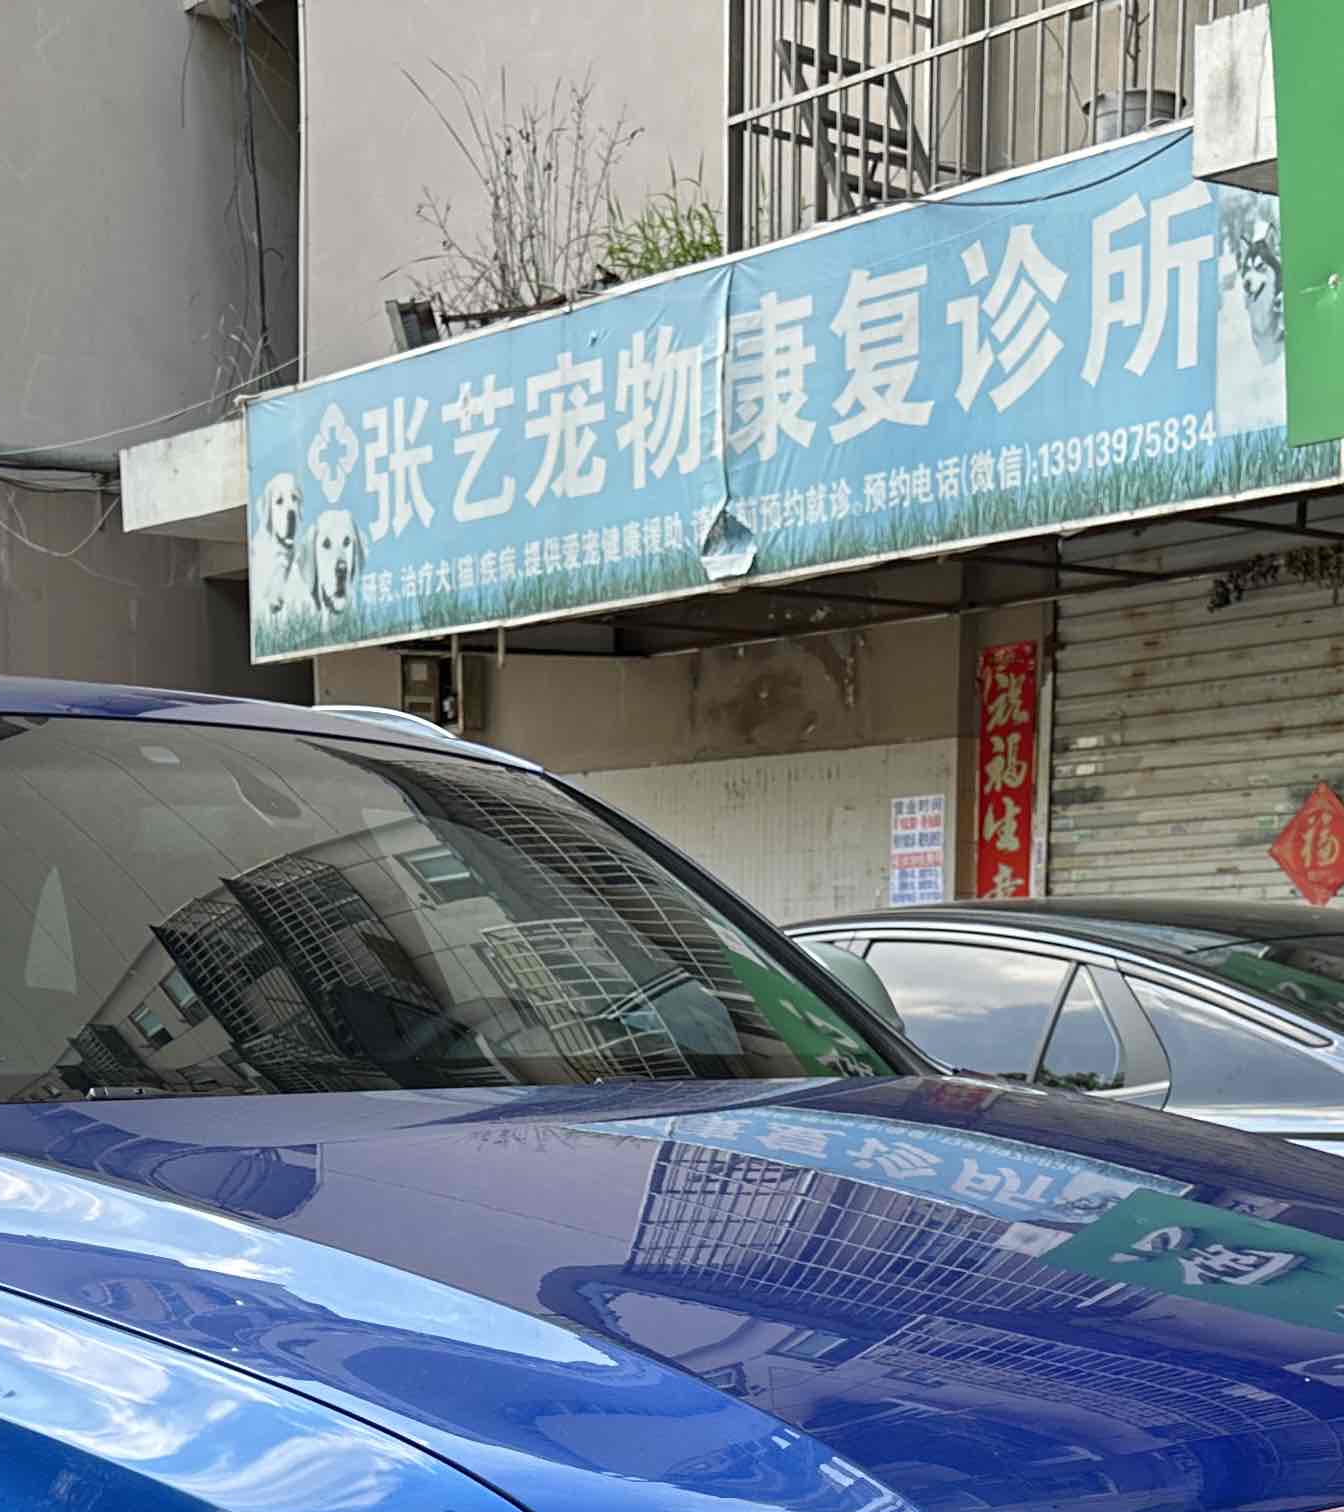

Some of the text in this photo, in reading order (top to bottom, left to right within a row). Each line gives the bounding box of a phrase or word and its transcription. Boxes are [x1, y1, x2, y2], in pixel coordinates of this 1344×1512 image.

[362, 182, 1216, 542] 张艺宠物康复诊所
[1300, 811, 1341, 869] 福
